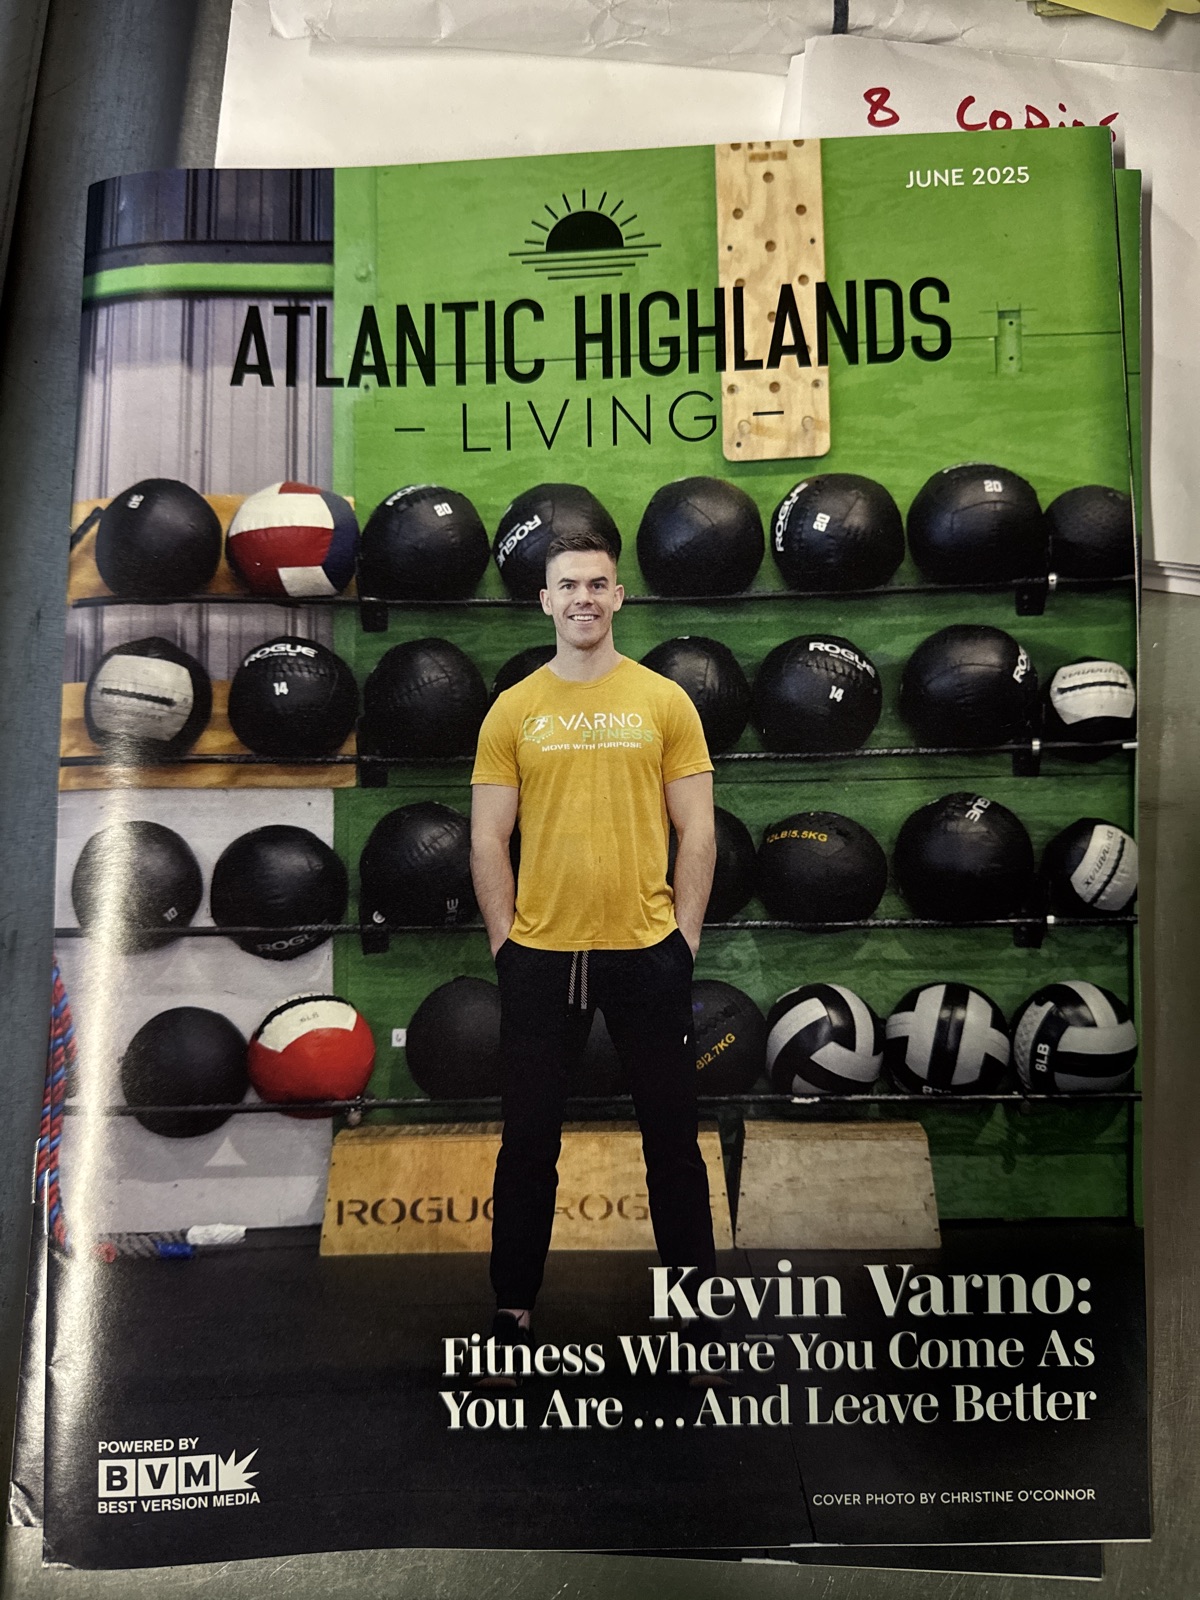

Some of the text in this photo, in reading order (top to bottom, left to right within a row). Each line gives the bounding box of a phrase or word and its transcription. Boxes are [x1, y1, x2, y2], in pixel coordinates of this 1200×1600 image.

[863, 86, 900, 128] 8
[906, 166, 1030, 188] JUNE 2025
[230, 276, 952, 388] ATLANTIC HIGHLANDS
[462, 390, 718, 452] LIVING
[983, 480, 1003, 492] 20
[433, 502, 454, 517] 20
[273, 681, 289, 696] 14
[829, 685, 845, 702] 14
[558, 712, 643, 731] VARNO
[581, 728, 654, 742] FITNESS
[541, 741, 643, 752] MOVE WITH PURPOSE
[1034, 1042, 1050, 1072] 8LB
[648, 1259, 1091, 1320] Kevin Varno:
[441, 1329, 1096, 1377] Fitness Where You Come As
[438, 1390, 528, 1430] You
[693, 1383, 793, 1428] And
[805, 1386, 939, 1425] Leave
[951, 1382, 1097, 1423] Better
[98, 1436, 200, 1454] POWERED BY
[103, 1459, 212, 1493] BVM
[97, 1491, 261, 1515] BEST VERSION MEDIA
[812, 1488, 1097, 1507] COVER PHOTO BY CHRISTINE O'CONNOR
